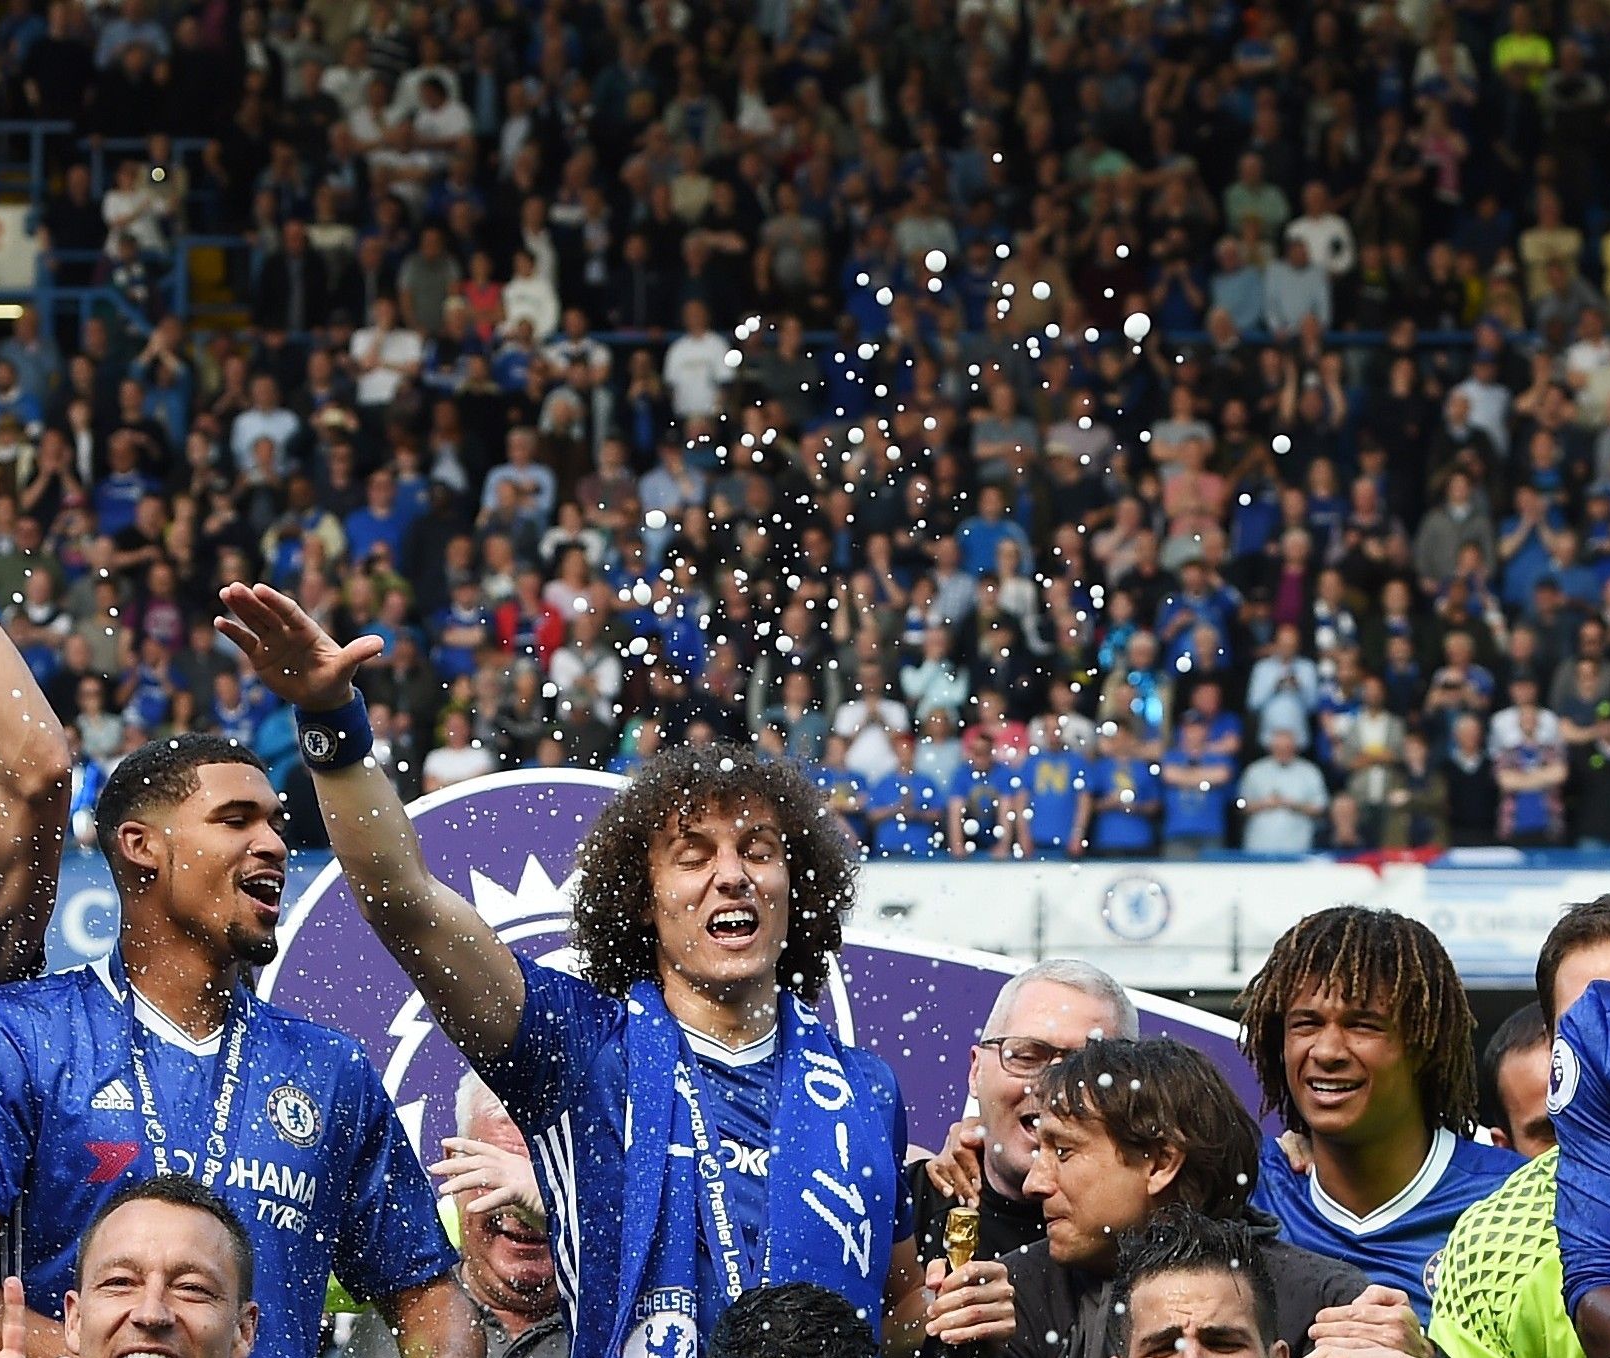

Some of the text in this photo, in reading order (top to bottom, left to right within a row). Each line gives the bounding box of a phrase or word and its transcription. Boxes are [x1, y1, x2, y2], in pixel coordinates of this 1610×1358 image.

[214, 1073, 240, 1132] League
[225, 1156, 318, 1211] HAMA
[706, 1181, 734, 1245] Premier
[721, 1241, 743, 1302] Leag
